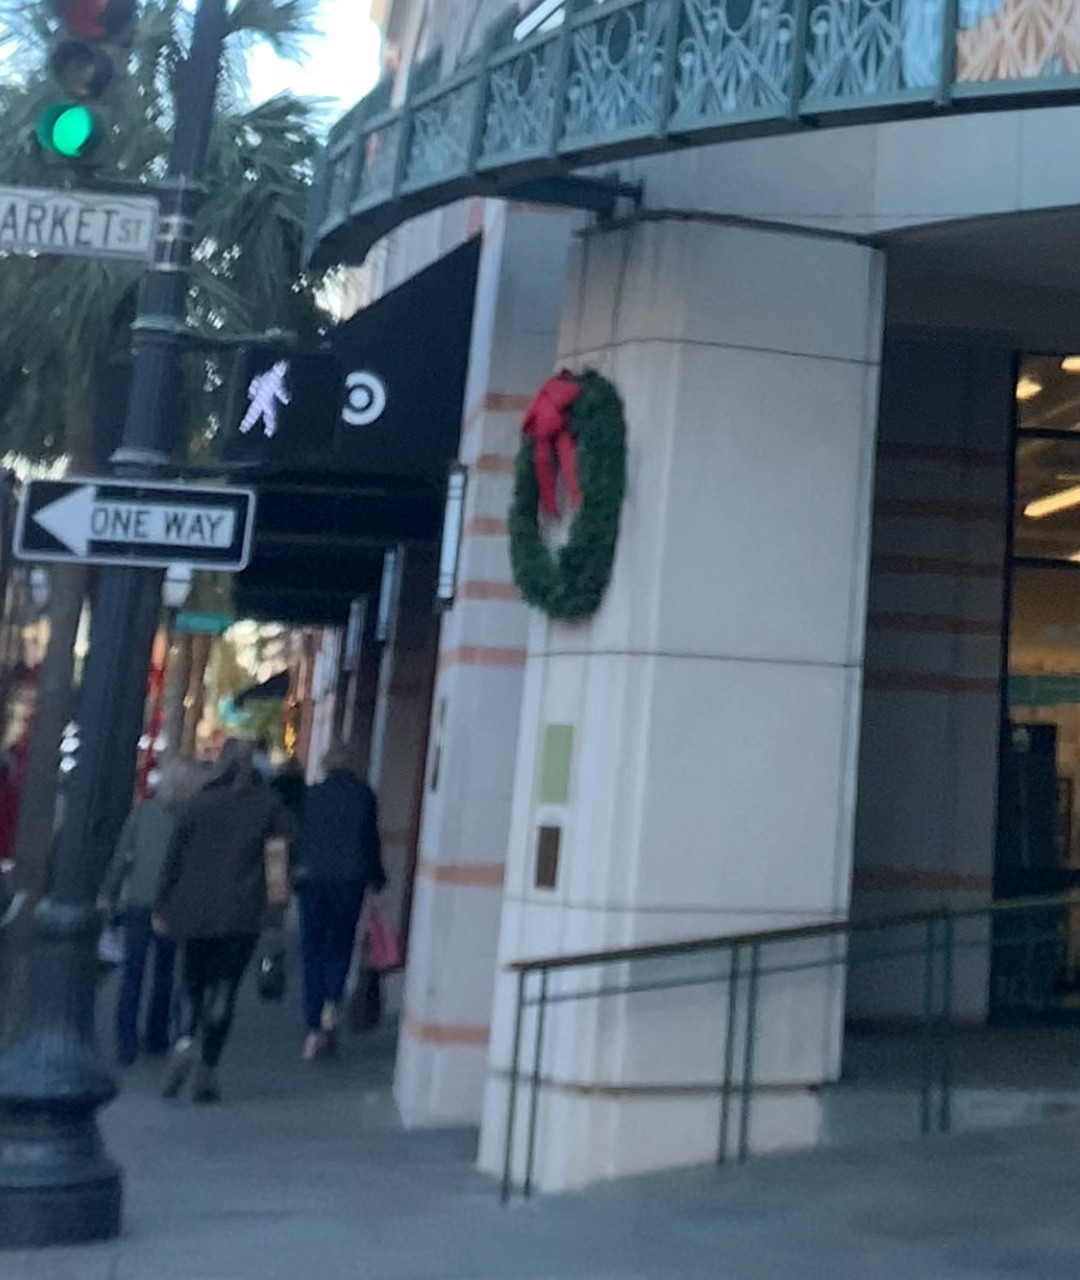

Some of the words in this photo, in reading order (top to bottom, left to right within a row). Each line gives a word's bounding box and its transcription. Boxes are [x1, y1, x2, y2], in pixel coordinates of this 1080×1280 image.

[0, 202, 120, 247] ARKET
[118, 218, 146, 245] ST
[91, 507, 150, 539] ONE
[164, 511, 224, 543] WAY
